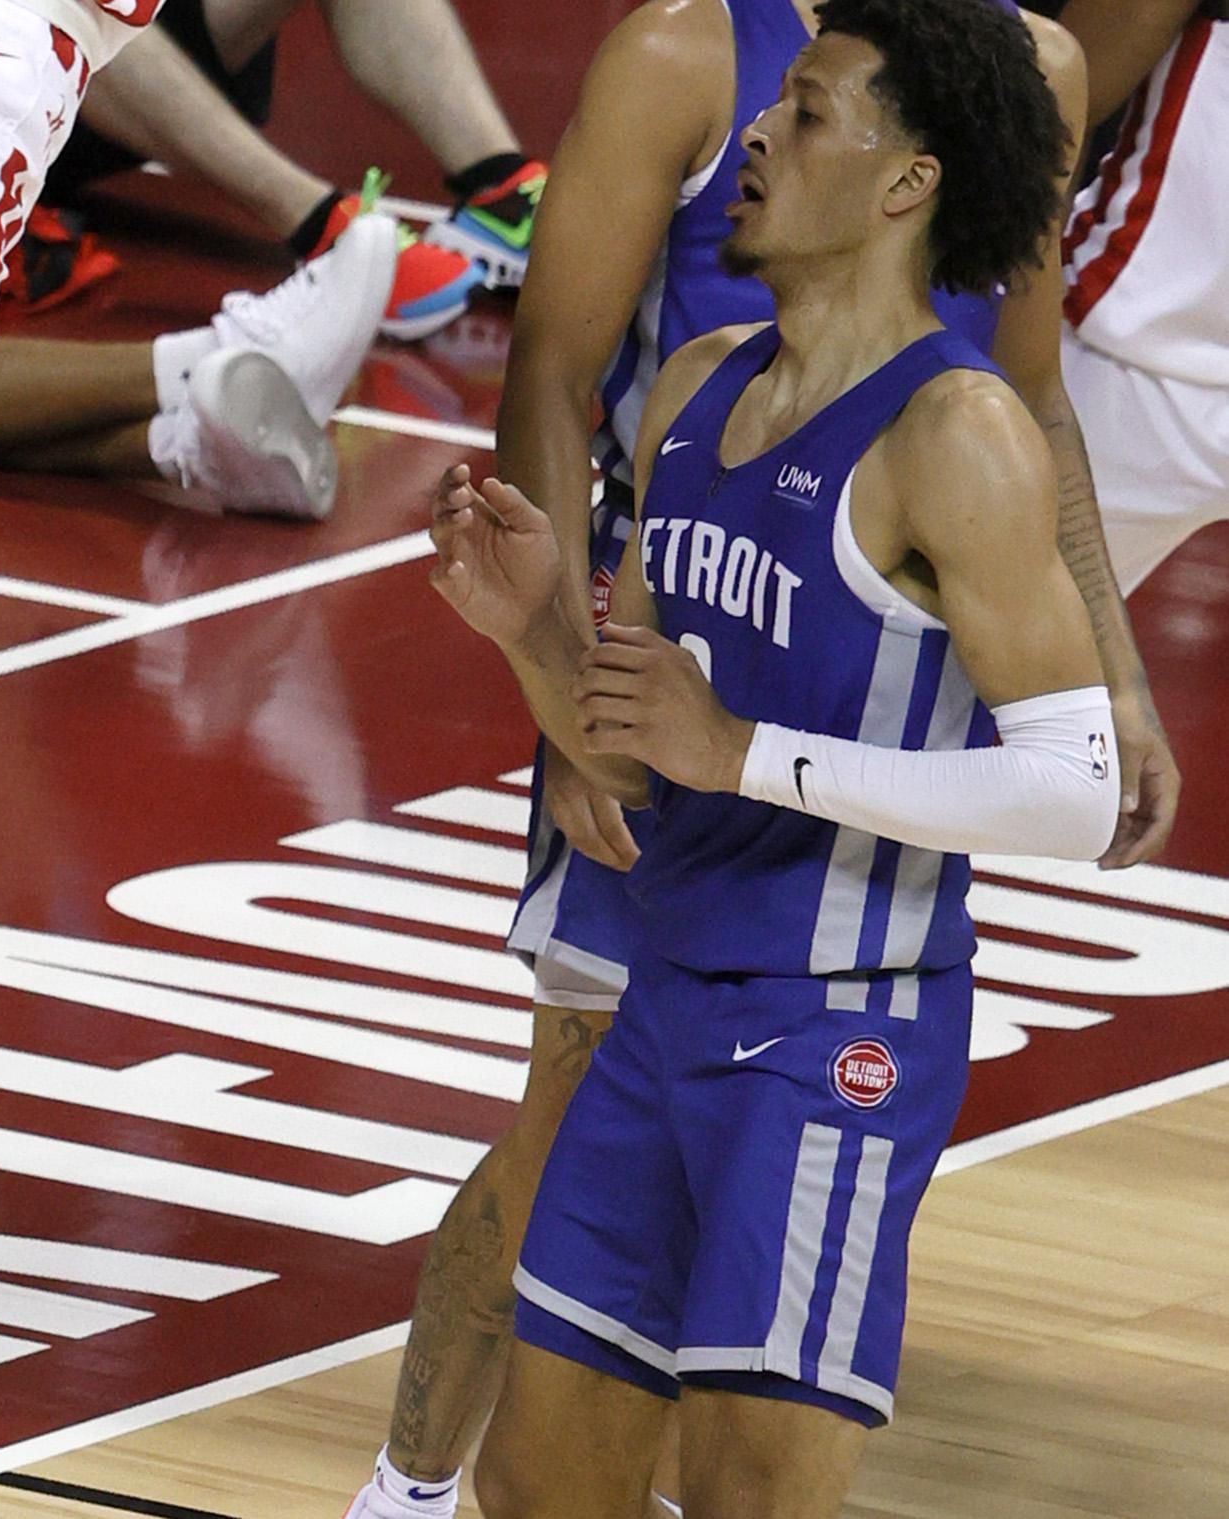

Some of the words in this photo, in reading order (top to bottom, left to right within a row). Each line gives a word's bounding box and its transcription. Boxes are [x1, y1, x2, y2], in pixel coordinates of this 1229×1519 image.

[777, 463, 822, 498] UWM
[638, 517, 803, 649] ETROIT
[844, 1071, 888, 1089] PISTONS
[845, 1059, 889, 1078] DETROIT
